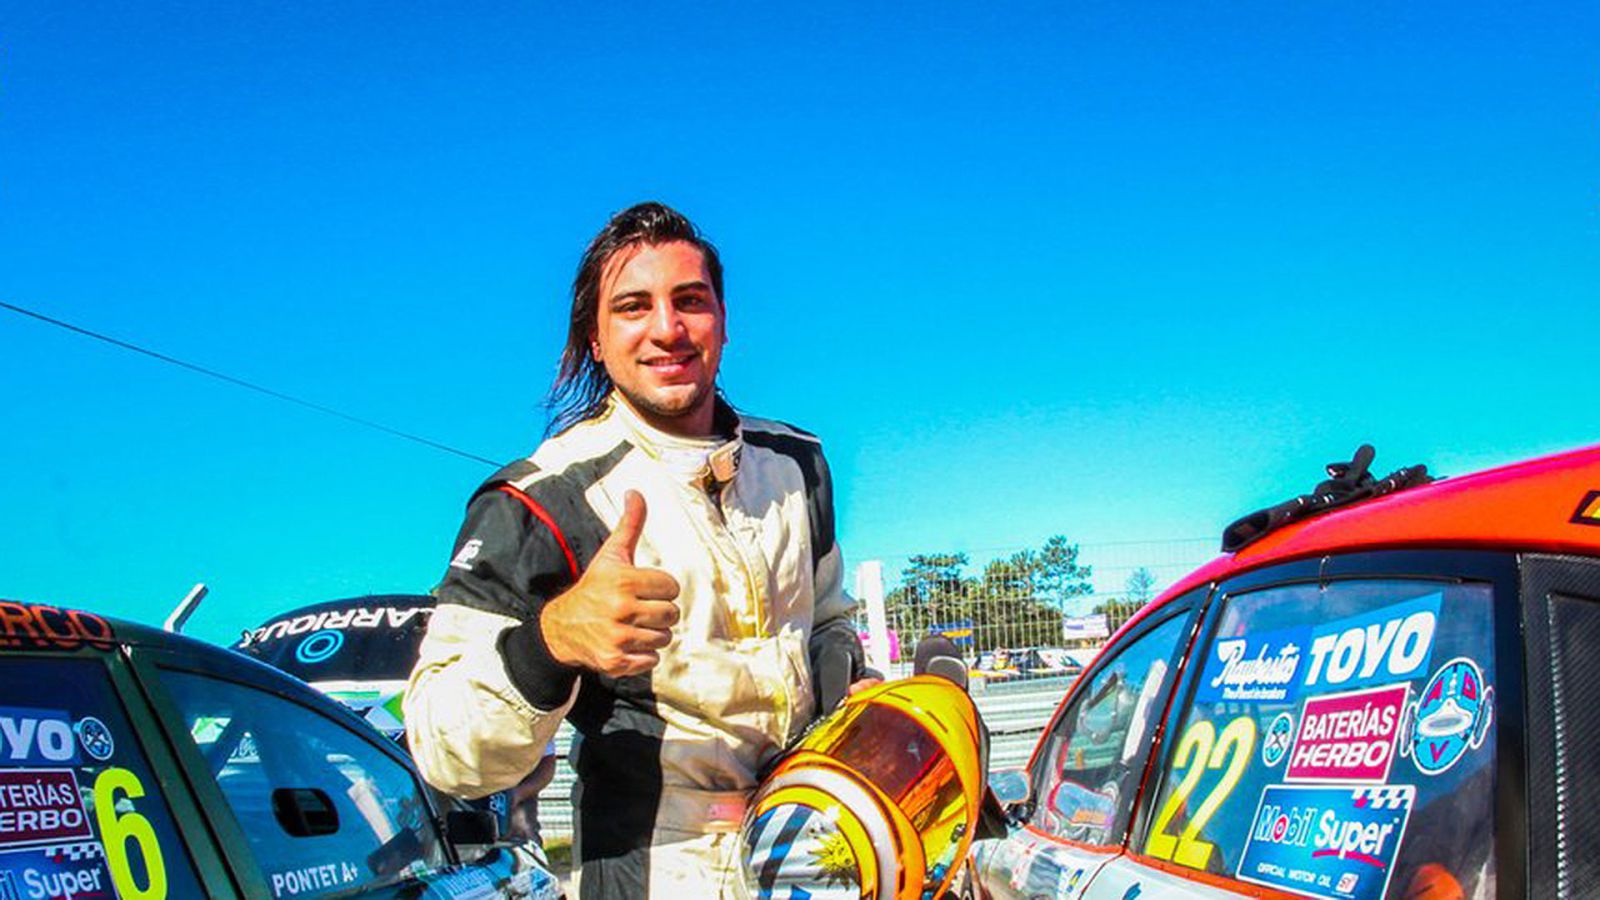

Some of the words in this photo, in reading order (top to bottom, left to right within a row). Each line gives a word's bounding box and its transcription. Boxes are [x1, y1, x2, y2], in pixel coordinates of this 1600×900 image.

[1304, 611, 1436, 686] TOYO
[0, 717, 75, 761] YO
[1301, 702, 1396, 741] BATERÍAS
[1292, 741, 1391, 768] HERBO
[1145, 716, 1256, 871] 22
[94, 768, 168, 900] 6
[1254, 804, 1318, 847] Mobil
[1314, 809, 1393, 860] Super
[23, 867, 101, 900] Super
[272, 863, 338, 897] PONTET
